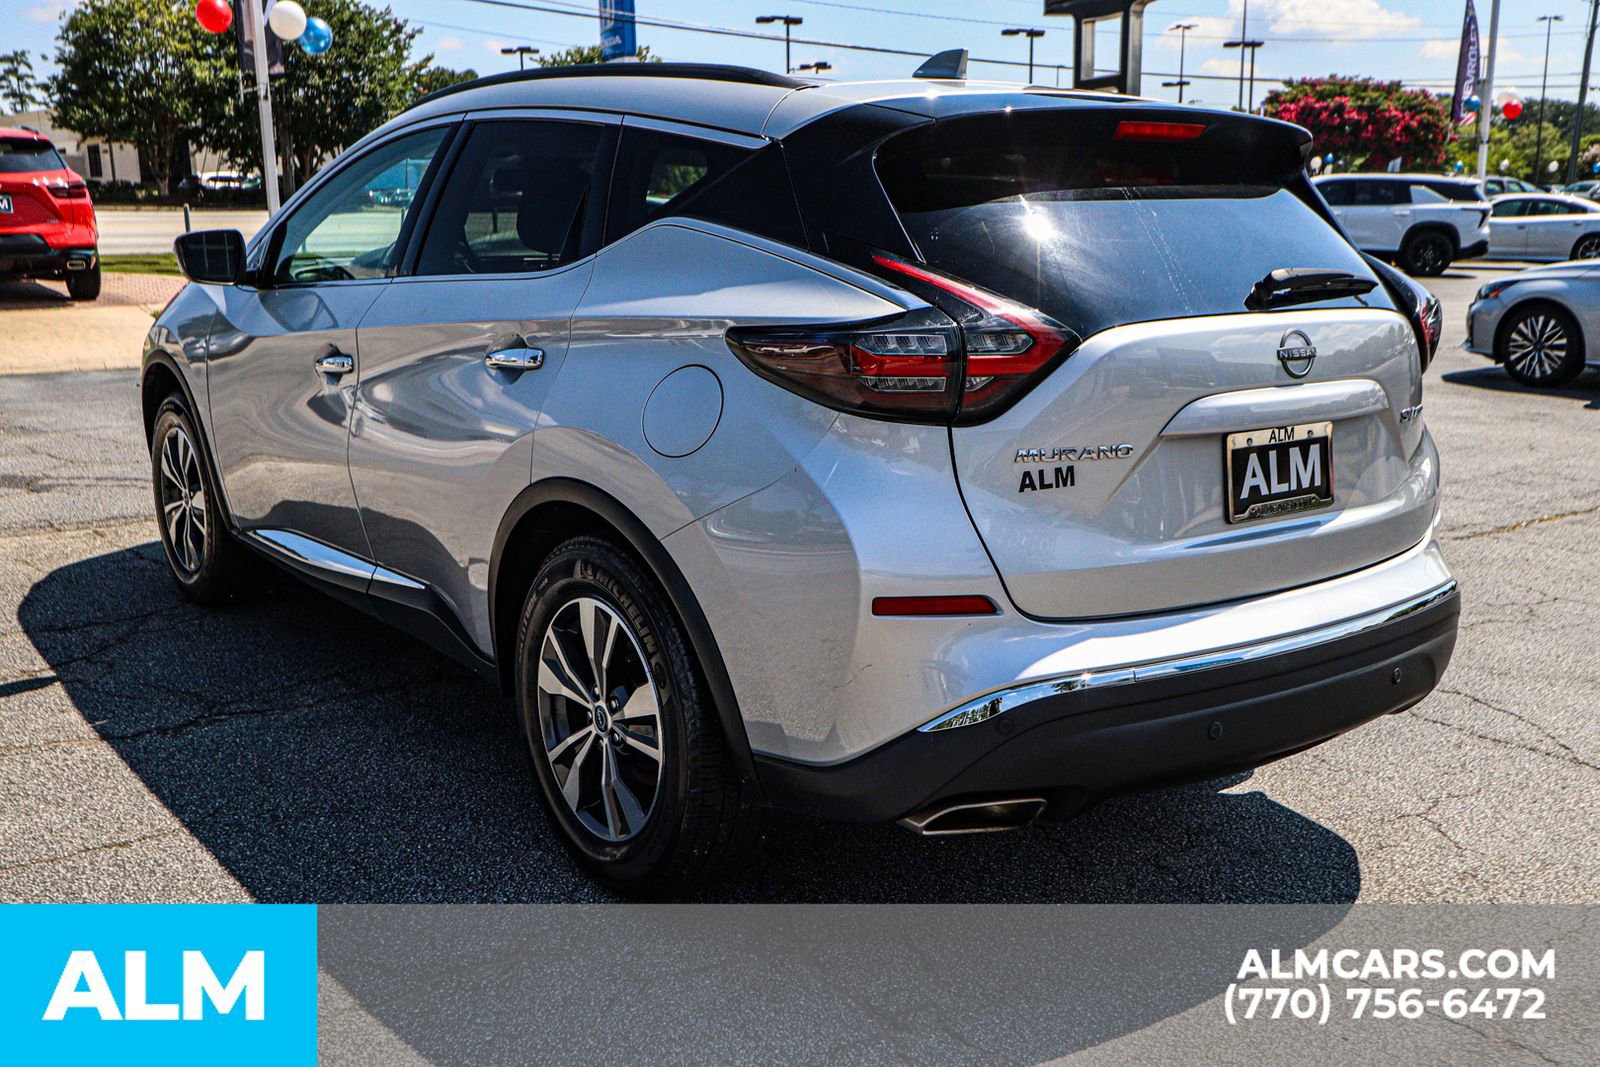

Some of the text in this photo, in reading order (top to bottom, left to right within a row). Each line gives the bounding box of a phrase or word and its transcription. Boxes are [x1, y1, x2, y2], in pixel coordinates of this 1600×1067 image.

[1268, 426, 1295, 443] ALM
[1014, 444, 1134, 463] MURANO
[1018, 465, 1075, 493] ALM
[1240, 443, 1321, 499] ALM
[595, 567, 659, 654] MICHELIN
